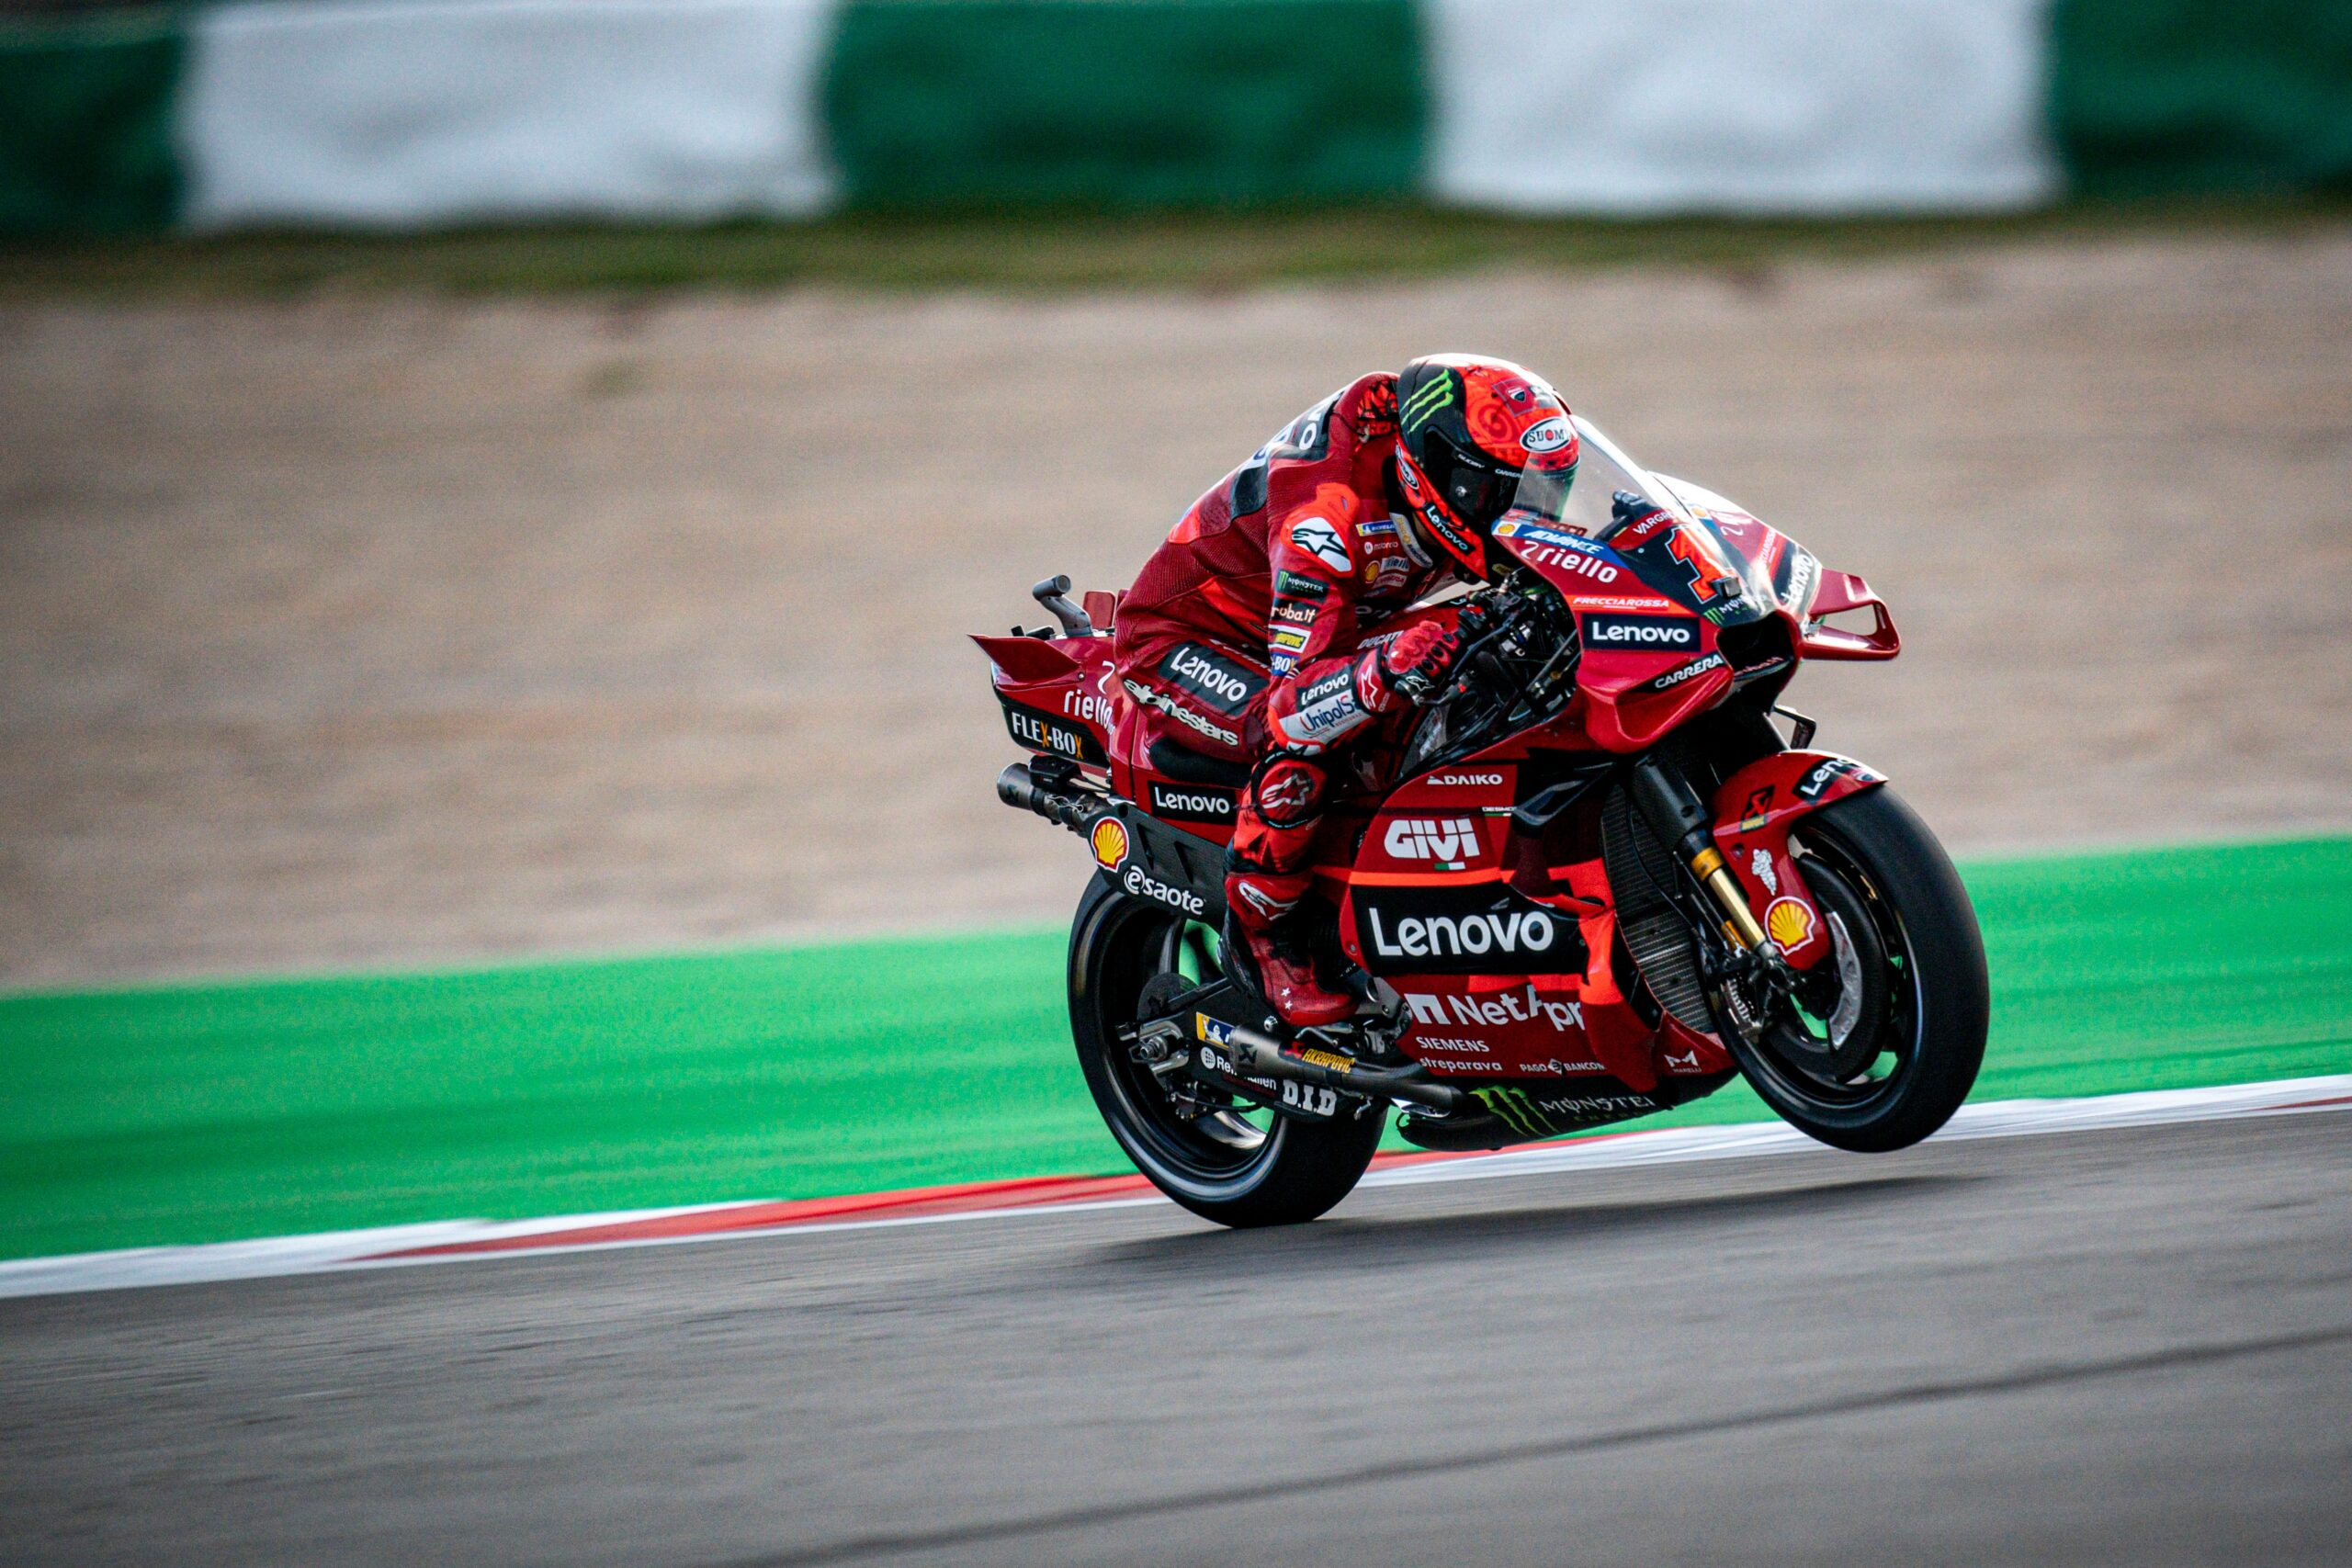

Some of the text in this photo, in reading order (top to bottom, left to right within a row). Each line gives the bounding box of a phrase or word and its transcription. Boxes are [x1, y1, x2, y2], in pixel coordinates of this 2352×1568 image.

[1426, 505, 1468, 550] Lenovo
[1523, 530, 1604, 554] ADVANCE
[1537, 548, 1618, 583] riello
[1288, 577, 1323, 592] MONSTER
[1272, 603, 1316, 623] ruba.it
[1573, 597, 1669, 607] FRECCIAROSSA
[1357, 630, 1404, 649] DUCATI
[1592, 621, 1690, 643] Lenovo
[1170, 647, 1247, 702] Lenovo
[1655, 654, 1724, 688] CARRERA
[1301, 673, 1349, 705] Lenovo
[1064, 689, 1113, 729] riello
[1124, 679, 1238, 746] alpinestars
[1300, 694, 1356, 731] UnipolS
[1012, 712, 1083, 759] FLEX-BOX
[1443, 774, 1503, 785] DAIKO
[1154, 786, 1230, 815] Lenovo
[1384, 818, 1480, 861] GIVI
[1124, 865, 1206, 916] esaote
[1369, 908, 1554, 956] Lenovo
[1416, 1036, 1490, 1053] SIEMENS
[1419, 1057, 1503, 1073] streparava
[1520, 1063, 1548, 1073] PAGO
[1283, 1078, 1338, 1117] D.I.D
